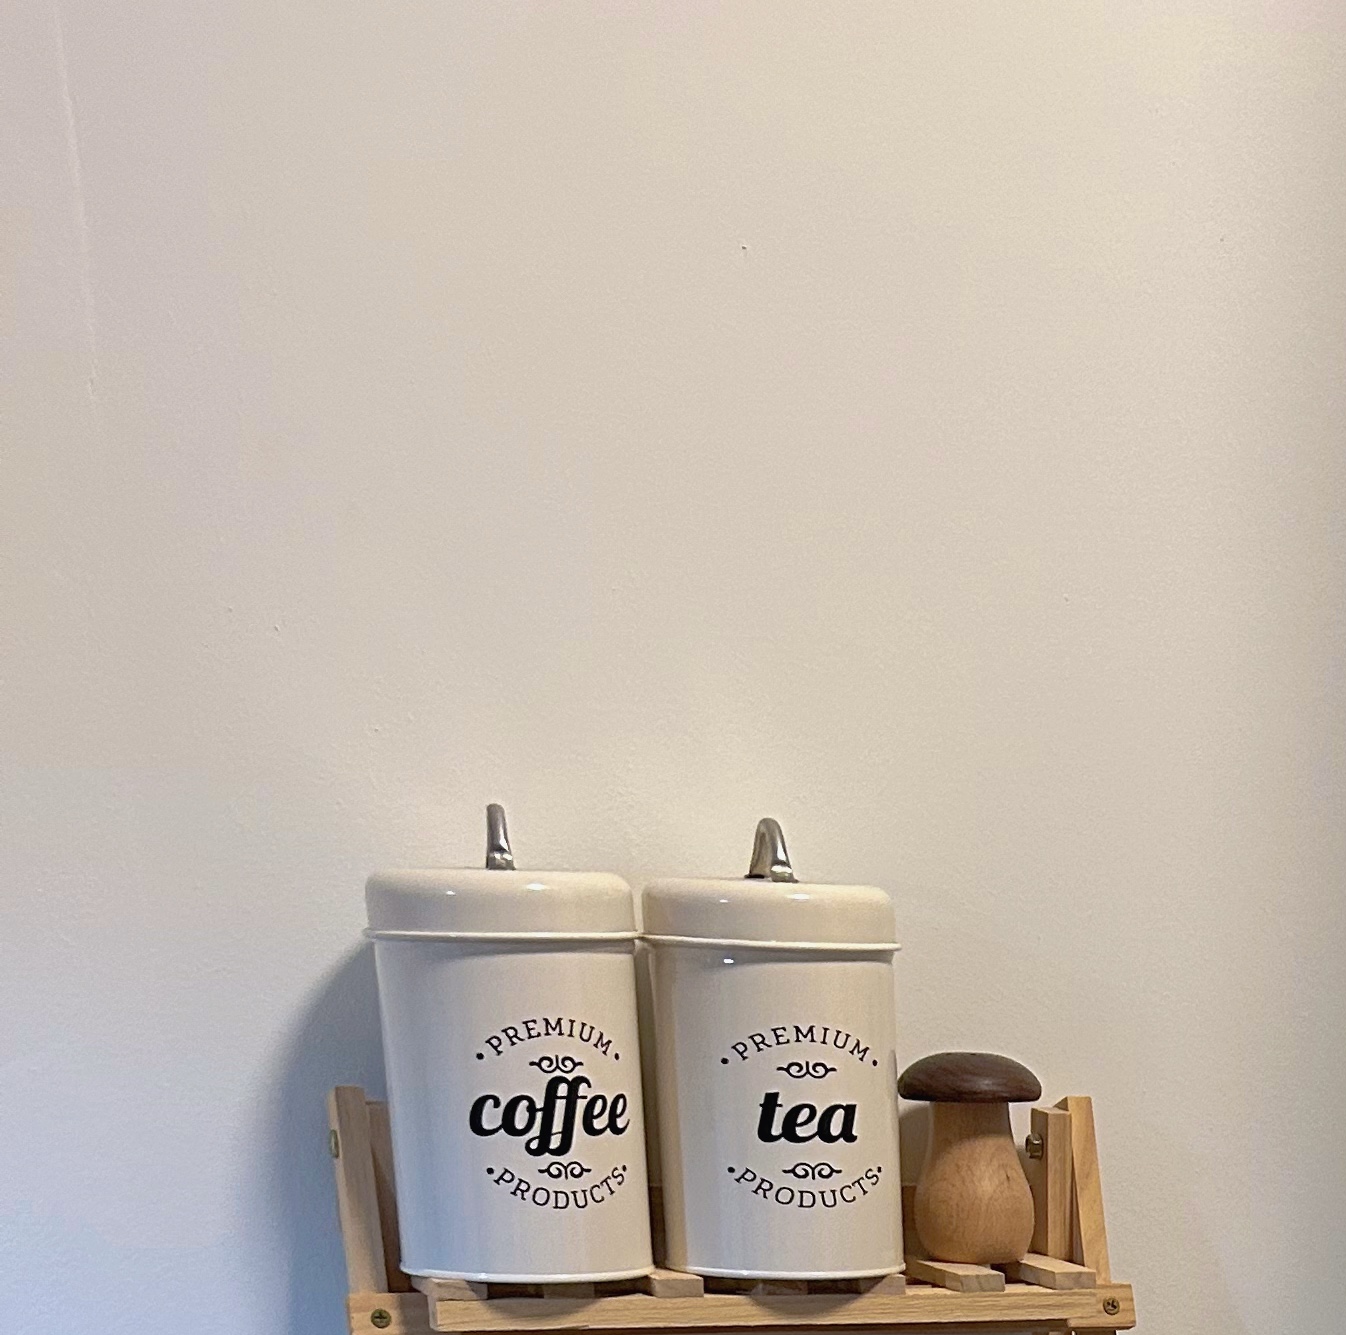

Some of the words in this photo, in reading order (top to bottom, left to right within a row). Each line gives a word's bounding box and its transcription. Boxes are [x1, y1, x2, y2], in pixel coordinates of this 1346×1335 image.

[485, 1016, 614, 1057] PREMIUM
[730, 1023, 871, 1063] PREMIUM
[468, 1075, 631, 1158] coffee
[756, 1091, 859, 1145] tea
[493, 1165, 626, 1210] PRODUCTS
[734, 1165, 882, 1209] PRODUCTS
